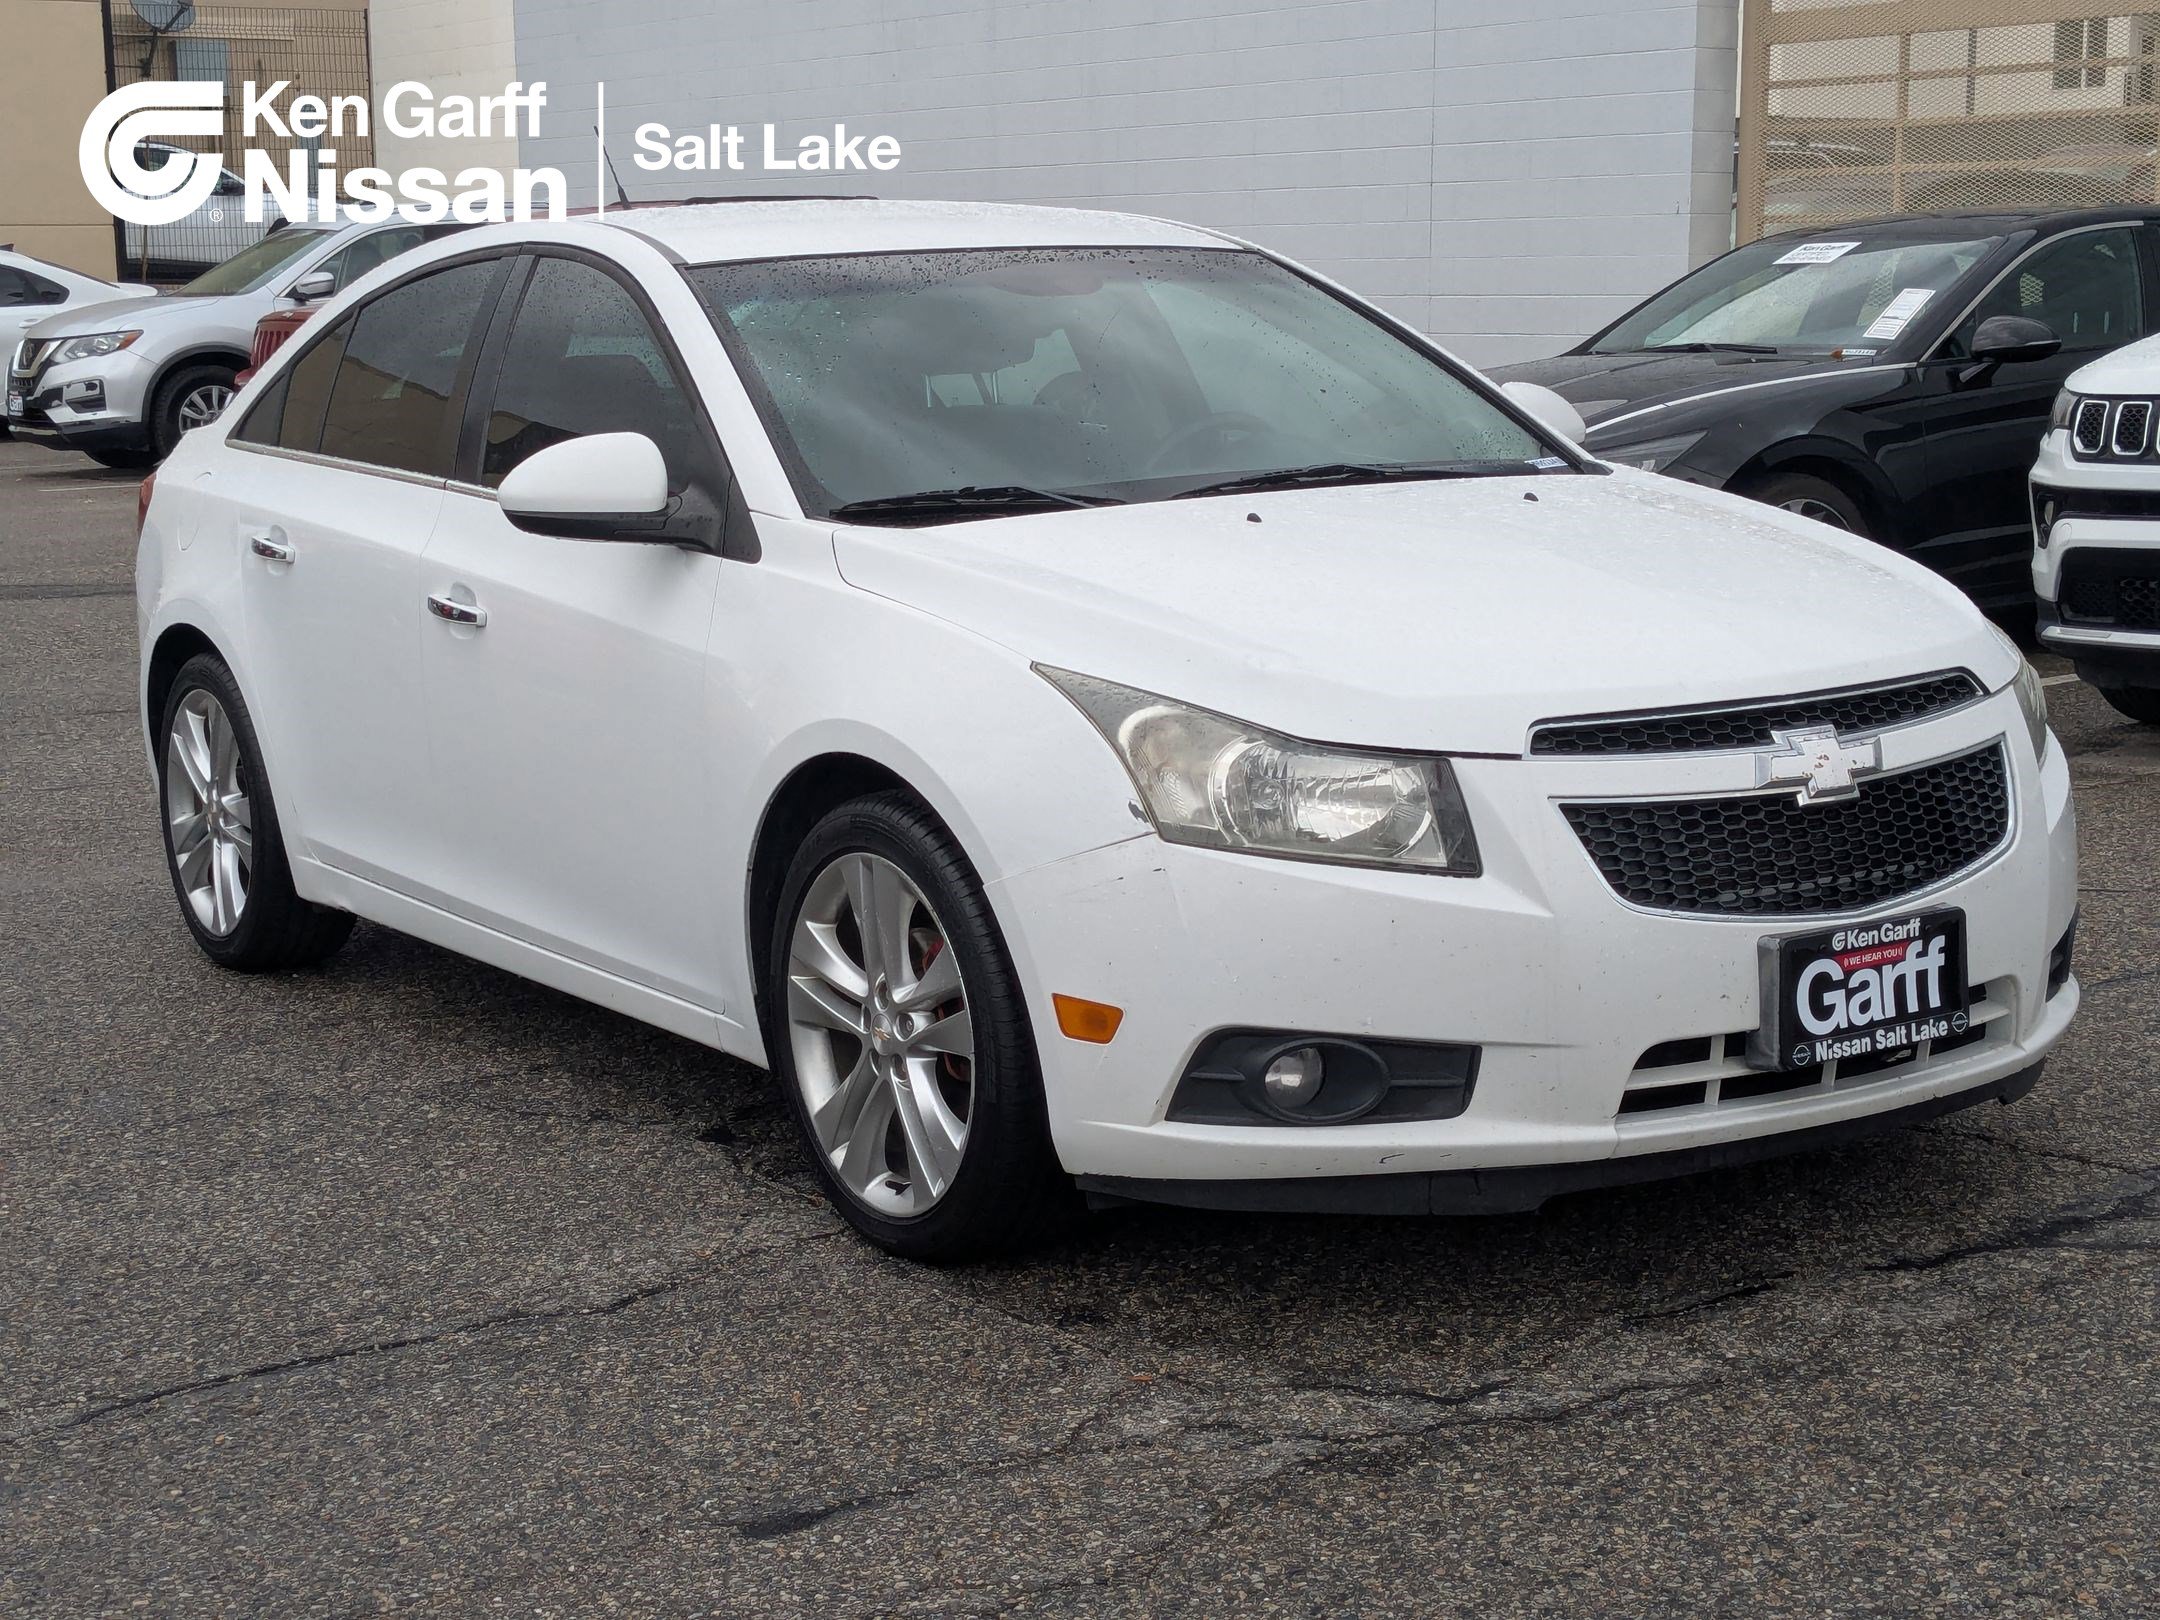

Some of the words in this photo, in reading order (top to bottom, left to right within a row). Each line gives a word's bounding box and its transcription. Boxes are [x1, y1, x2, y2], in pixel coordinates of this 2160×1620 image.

[1847, 928, 1879, 949] Ken
[1880, 918, 1921, 942] Garff
[1849, 955, 1861, 966] WE
[1862, 951, 1882, 963] HEAR
[1882, 948, 1898, 959] YOU
[1796, 935, 1946, 1036] Garff
[1815, 1036, 1872, 1062] Nissan
[1875, 1025, 1908, 1050] Salt
[1911, 1019, 1949, 1043] Lake
